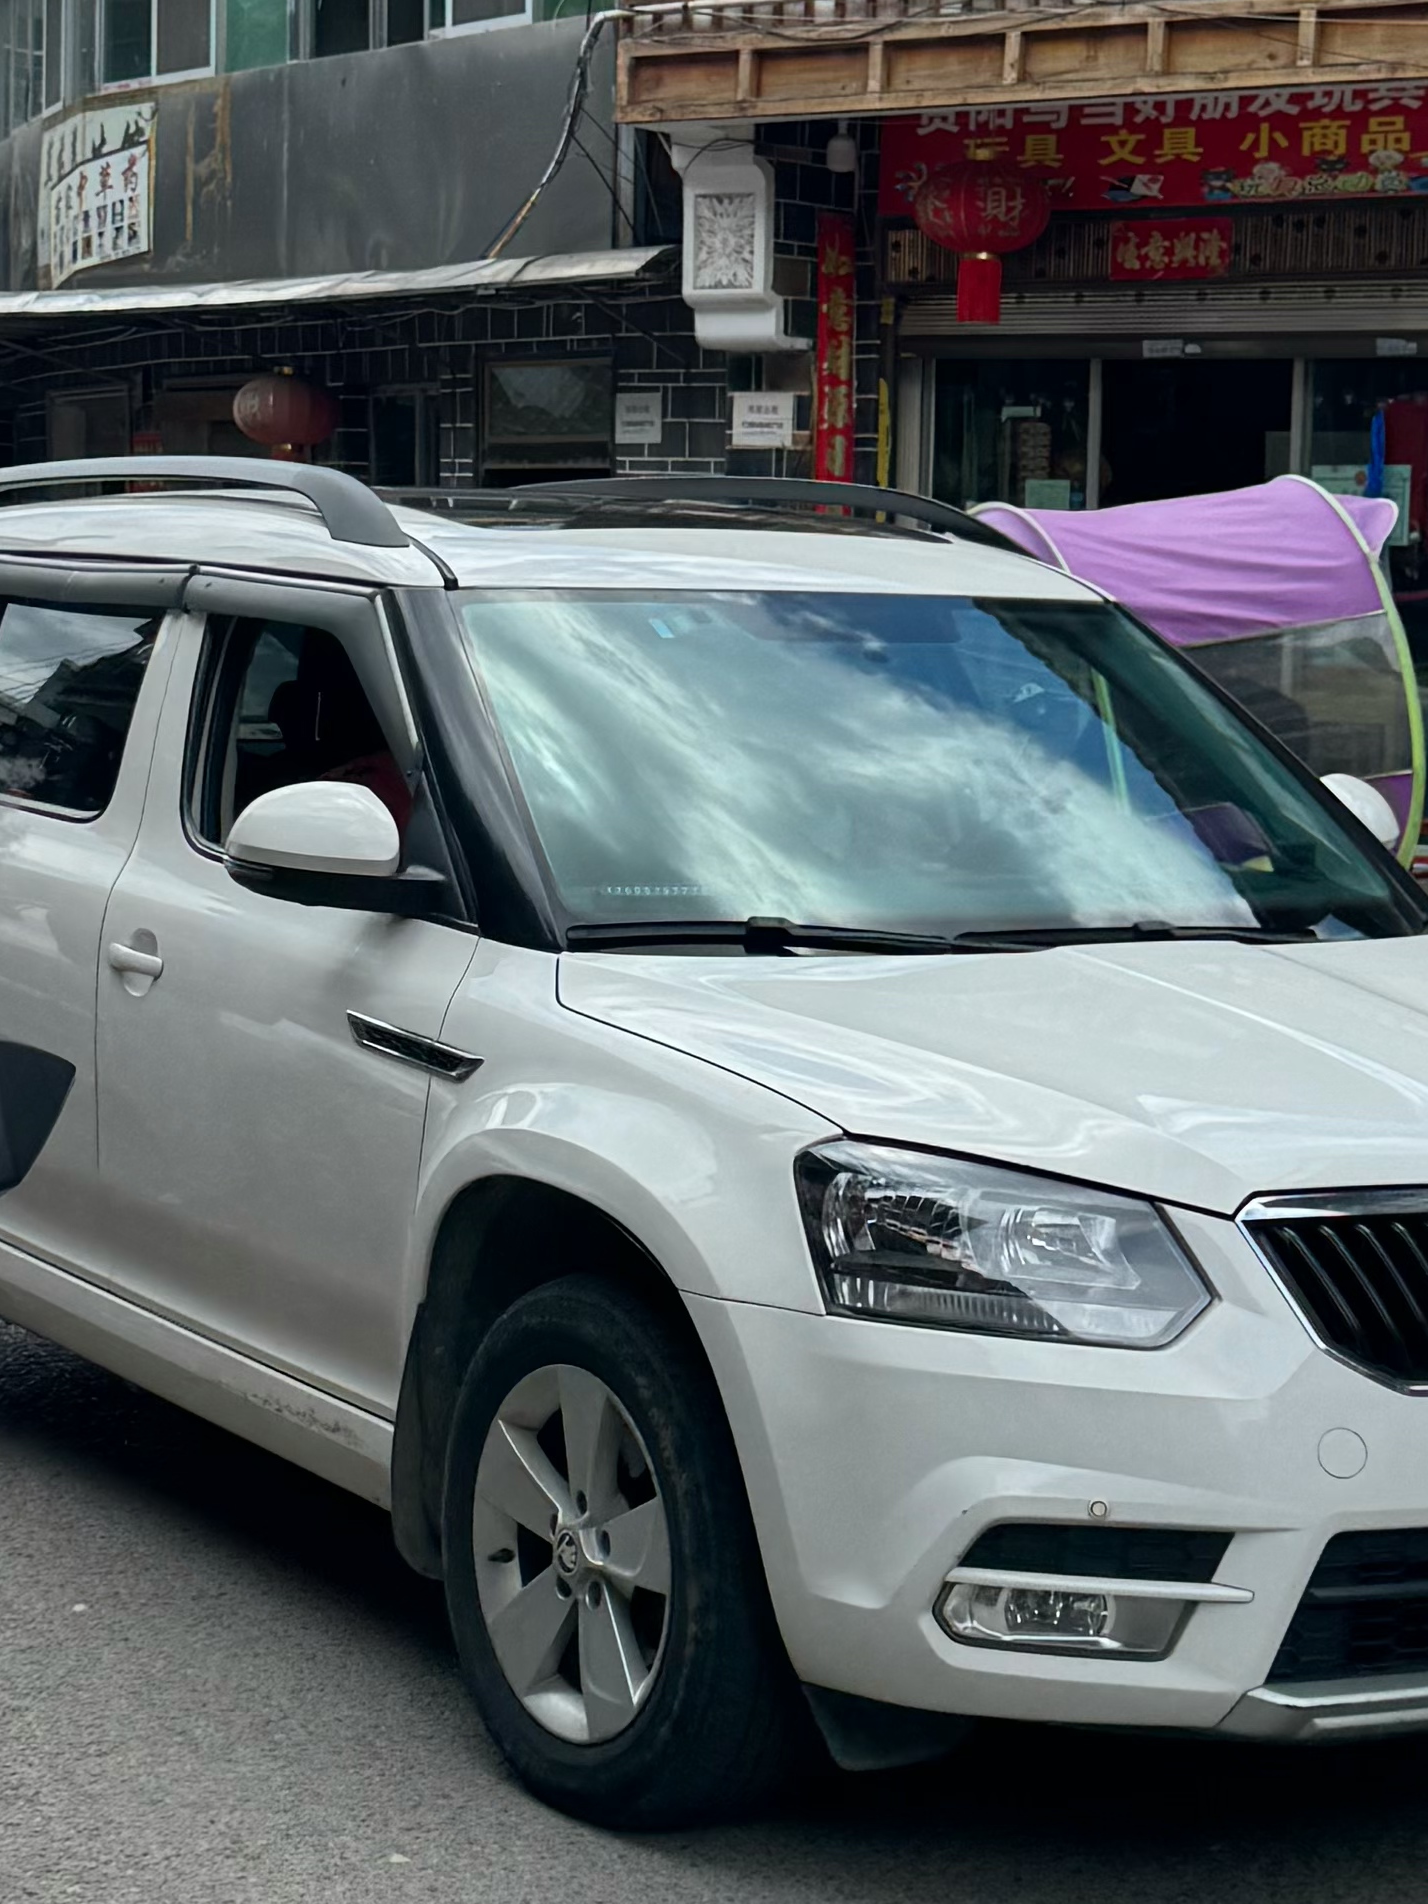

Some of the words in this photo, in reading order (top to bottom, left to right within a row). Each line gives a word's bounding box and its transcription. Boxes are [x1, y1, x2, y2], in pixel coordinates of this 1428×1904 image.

[1097, 127, 1204, 166] 文具
[1239, 115, 1412, 159] 小商品
